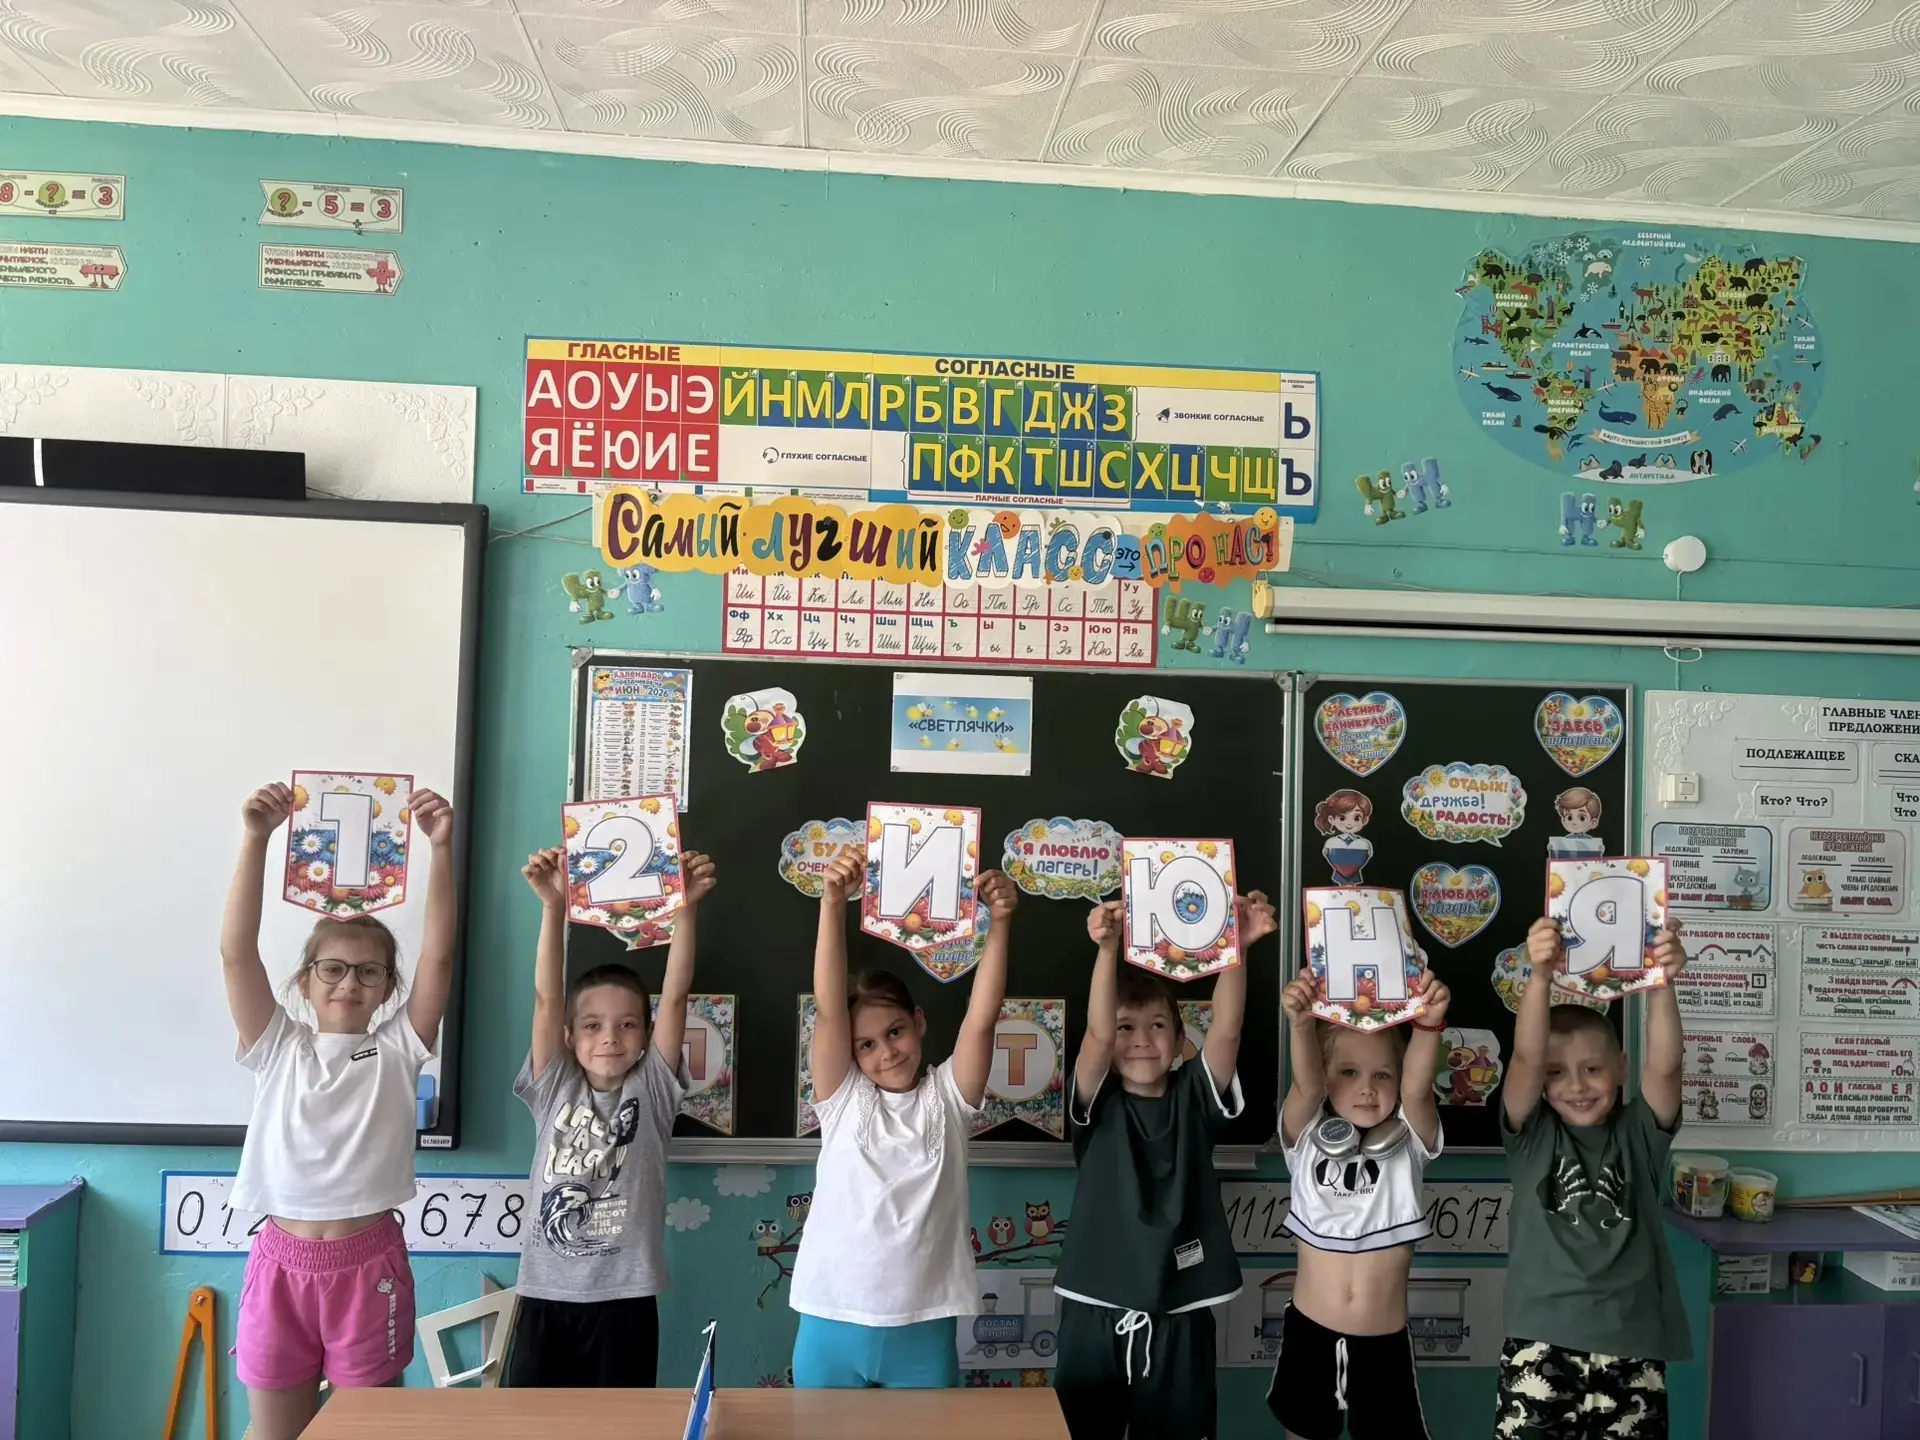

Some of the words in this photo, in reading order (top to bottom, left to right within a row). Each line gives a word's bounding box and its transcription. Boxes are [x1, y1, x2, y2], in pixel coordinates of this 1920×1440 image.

[0, 182, 13, 203] 8
[98, 186, 113, 205] 3
[324, 195, 339, 215] 5
[377, 199, 391, 218] 3
[568, 342, 680, 362] ГЛАСНЫЕ
[935, 358, 1075, 379] СОГЛАСНЫЕ
[1174, 412, 1212, 422] ЗВОНКИЕ
[1214, 413, 1264, 423] СОГЛАСНЫЕ
[1284, 402, 1311, 440] Ь
[781, 452, 813, 461] ГЛУХИЕ
[815, 453, 867, 463] СОГЛАСНЫЕ
[1281, 458, 1312, 496] Ъ
[975, 494, 1010, 503] ПАРНЫЕ
[1012, 496, 1064, 505] СОГЛАСНЫЕ
[607, 494, 742, 560] Самый
[947, 522, 1118, 584] КЛАСС
[1145, 533, 1207, 582] ПРО
[1213, 523, 1274, 566] НАС!
[1123, 582, 1140, 594] Уу
[729, 610, 750, 621] Фф
[766, 612, 784, 621] Хх
[803, 613, 821, 624] Цц
[840, 614, 856, 624] Чч
[875, 616, 897, 626] Шш
[911, 618, 934, 628] Щщ
[947, 619, 958, 628] Ъ
[983, 621, 994, 630] Ы
[1018, 622, 1027, 631] Ь
[1053, 623, 1069, 632] Ээ
[1088, 625, 1112, 635] Юю
[1122, 626, 1138, 635] Яя
[648, 686, 669, 698] 2026
[1822, 706, 1886, 720] ГЛАВНЫЕ
[908, 718, 1015, 734] «СВЕТЛЯЧКИ»
[1552, 719, 1604, 735] ЗДЕСЬ
[1746, 749, 1845, 762] ПОДЛЕЖАЩЕЕ
[1448, 777, 1509, 793] ОТДЫХ!
[1760, 795, 1792, 806] Кто?
[1796, 796, 1829, 807] Что?
[1435, 809, 1512, 826] РАДОСТЬ!
[1894, 807, 1918, 818] Что
[321, 792, 373, 889] 1
[1023, 842, 1034, 856] Я
[1039, 844, 1110, 860] ЛЮБЛЮ
[584, 814, 666, 905] 2
[879, 823, 965, 921] И
[1432, 889, 1490, 900] ЛЮБЛЮ
[1128, 855, 1230, 952] Ю
[1567, 875, 1645, 976] Я
[1690, 931, 1723, 939] РАЗБОРА
[1737, 932, 1770, 941] СОСТАВУ
[1323, 907, 1408, 1001] Н
[1708, 953, 1715, 961] 3
[1735, 954, 1741, 962] 4
[1759, 955, 1766, 963] 5
[1732, 1036, 1757, 1044] СЛОВА
[1835, 1037, 1854, 1045] ЕСЛИ
[1855, 1038, 1891, 1046] ГЛАСНЫЙ
[996, 1033, 1038, 1086] Т
[1804, 1047, 1820, 1056] ПОД
[1876, 1050, 1899, 1058] СТАВЬ
[1900, 1050, 1913, 1058] ЕГО
[1832, 1060, 1849, 1068] ПОД
[1683, 1080, 1712, 1089] ФОРМЫ
[1714, 1081, 1739, 1089] СЛОВА
[1805, 1081, 1814, 1094] А
[1819, 1082, 1828, 1093] О
[1834, 1082, 1843, 1094] И
[1891, 1083, 1899, 1095] Е
[1905, 1083, 1913, 1095] Я
[1833, 1094, 1869, 1102] ГЛАСНЫХ
[1870, 1095, 1893, 1103] РОВНО
[1815, 1105, 1833, 1113] НАМ
[1834, 1105, 1845, 1113] ИХ
[1845, 1106, 1866, 1114] НАДО
[177, 1191, 204, 1236] 0
[420, 1192, 450, 1238] 6
[460, 1192, 488, 1238] 7
[497, 1193, 525, 1238] 8
[592, 1219, 612, 1228] THE
[587, 1225, 623, 1237] WAVES
